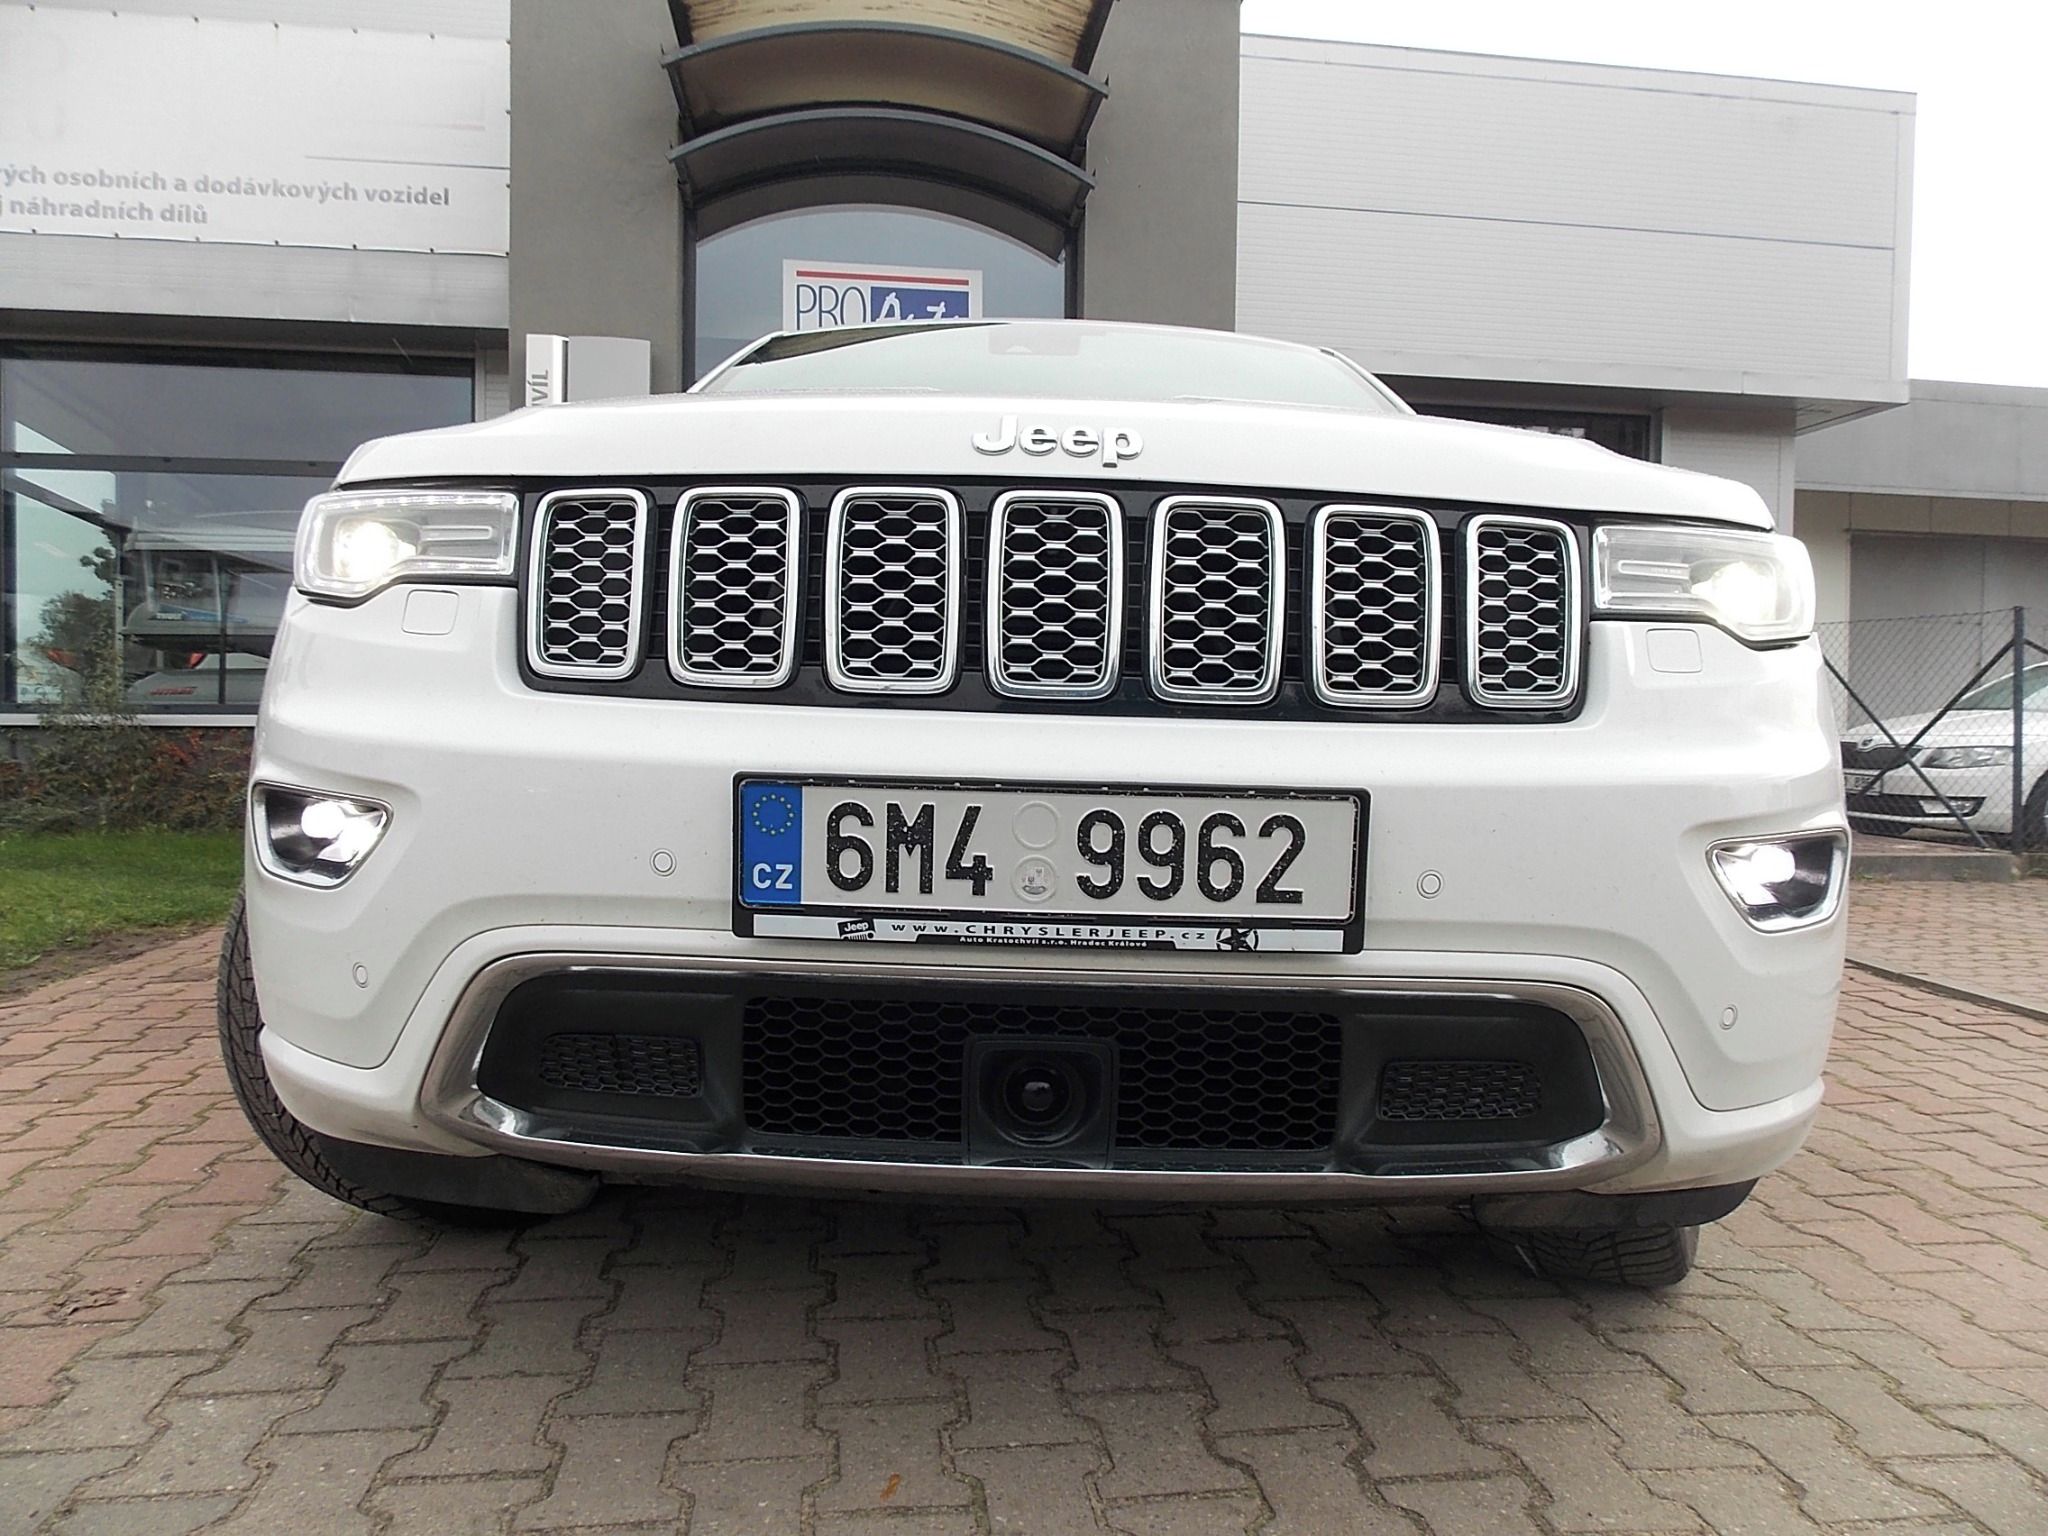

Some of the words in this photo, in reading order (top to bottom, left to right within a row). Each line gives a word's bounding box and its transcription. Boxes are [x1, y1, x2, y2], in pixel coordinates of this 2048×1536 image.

[0, 163, 46, 187] ých
[53, 168, 167, 192] osobních
[173, 177, 188, 193] a
[194, 174, 358, 204] dodávkových
[364, 185, 450, 206] vozidel
[10, 196, 153, 222] náhradních
[160, 202, 208, 225] dílů
[796, 284, 867, 331] PRO
[527, 369, 549, 407] VÍL
[971, 414, 1144, 469] Jeep
[826, 801, 994, 896] 6M4
[1075, 809, 1306, 904] 9962
[752, 862, 793, 890] CZ
[843, 920, 869, 932] Jeep
[1070, 939, 1106, 947] Hradec
[1108, 940, 1148, 948] Králové
